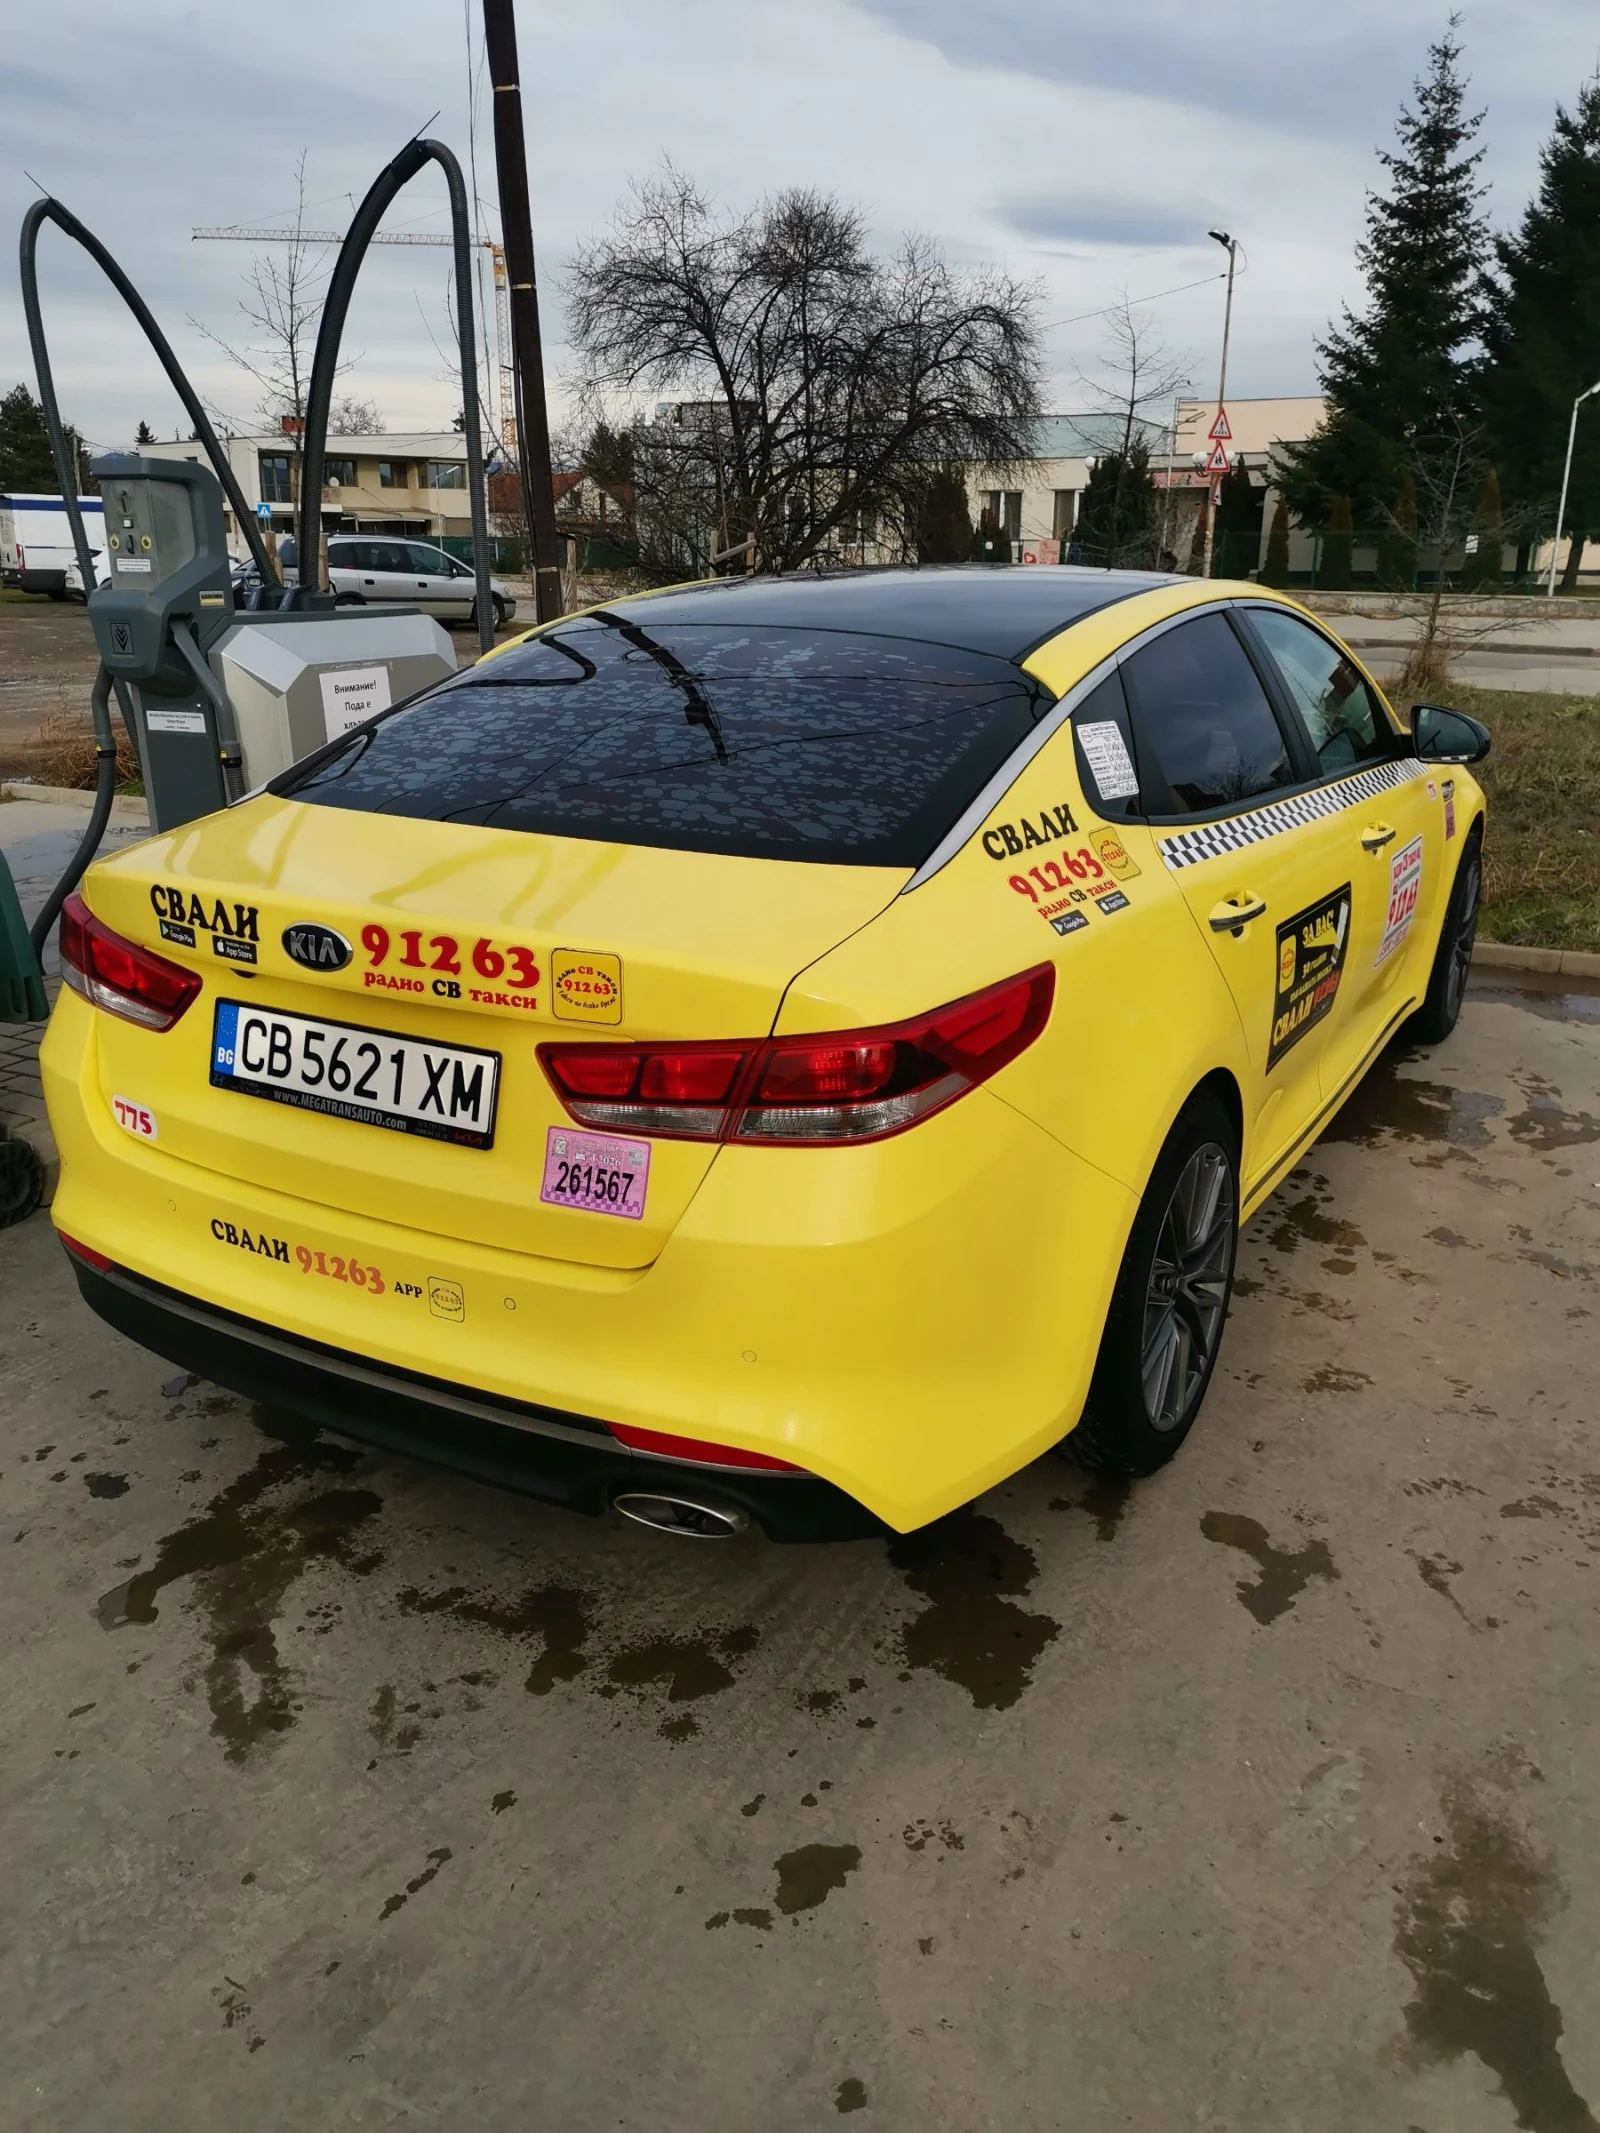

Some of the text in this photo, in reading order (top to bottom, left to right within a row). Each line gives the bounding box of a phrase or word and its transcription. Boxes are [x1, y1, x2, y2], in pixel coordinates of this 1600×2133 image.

[334, 679, 377, 694] Внимание!
[366, 700, 371, 708] е
[982, 803, 1079, 860] СВАЛИ
[1008, 849, 1104, 903] 91263
[150, 884, 260, 941] СВАЛИ
[1037, 897, 1072, 919] радио
[1069, 888, 1087, 903] СВ
[1086, 880, 1117, 897] такси
[169, 930, 185, 943] Google
[226, 947, 253, 960] App Store
[290, 930, 340, 964] KIA
[361, 923, 541, 989] 91263
[577, 965, 594, 976] СВ
[364, 971, 538, 1010] радио СВ такси
[563, 979, 611, 995] 91263
[1273, 990, 1315, 1046] СВАЛИ
[217, 1046, 234, 1066] BG
[114, 1099, 152, 1135] 775
[273, 1089, 407, 1131] www.MEGATRANSAUTO.com
[598, 1154, 621, 1167] 2026
[555, 1161, 635, 1204] 261567
[210, 1218, 290, 1263] СВАЛИ
[295, 1245, 386, 1295] 91263
